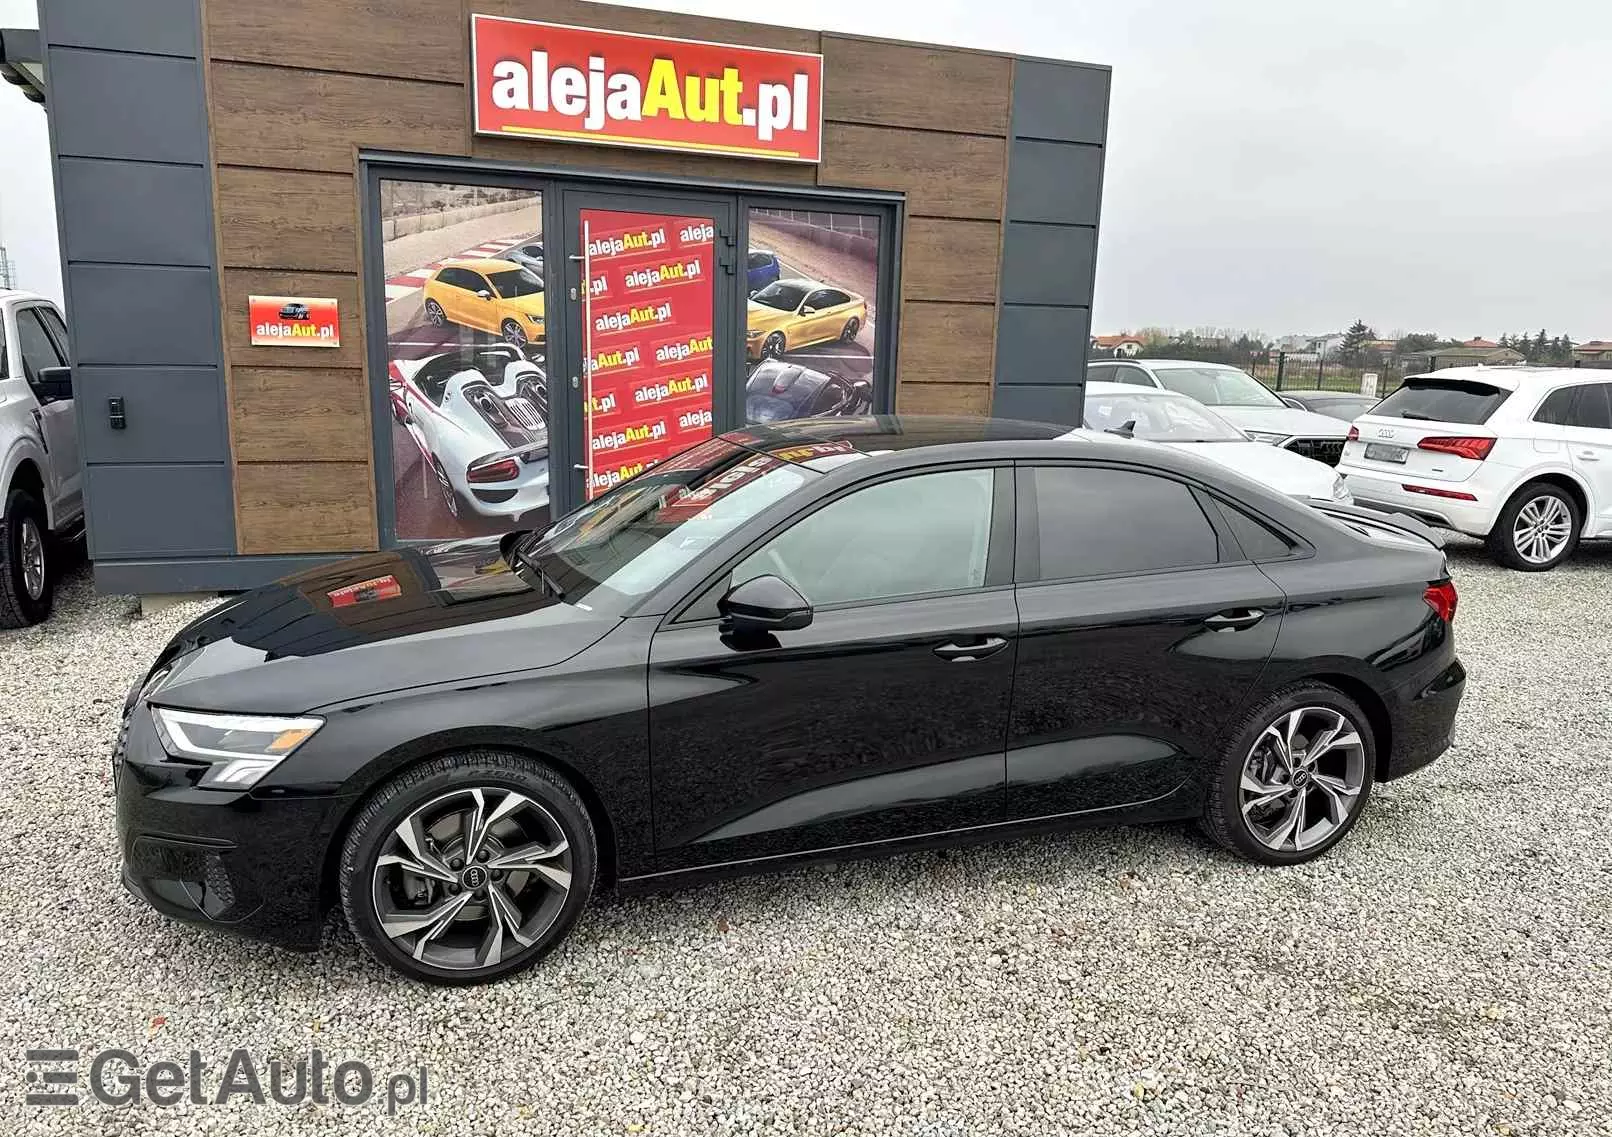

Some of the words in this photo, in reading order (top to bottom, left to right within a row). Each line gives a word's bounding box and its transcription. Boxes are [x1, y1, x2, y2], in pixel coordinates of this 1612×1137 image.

[492, 51, 808, 141] alejaAut.pl
[588, 228, 666, 256] alejaAut.pl
[680, 224, 714, 243] aleja
[625, 259, 701, 288] alejaAut.pl
[256, 321, 334, 340] alejaAut.pl
[595, 302, 672, 331] alejaAut.pl
[635, 373, 708, 402] alejaAut.pl
[679, 410, 712, 428] aleja
[592, 421, 666, 449] alejaAut.pl
